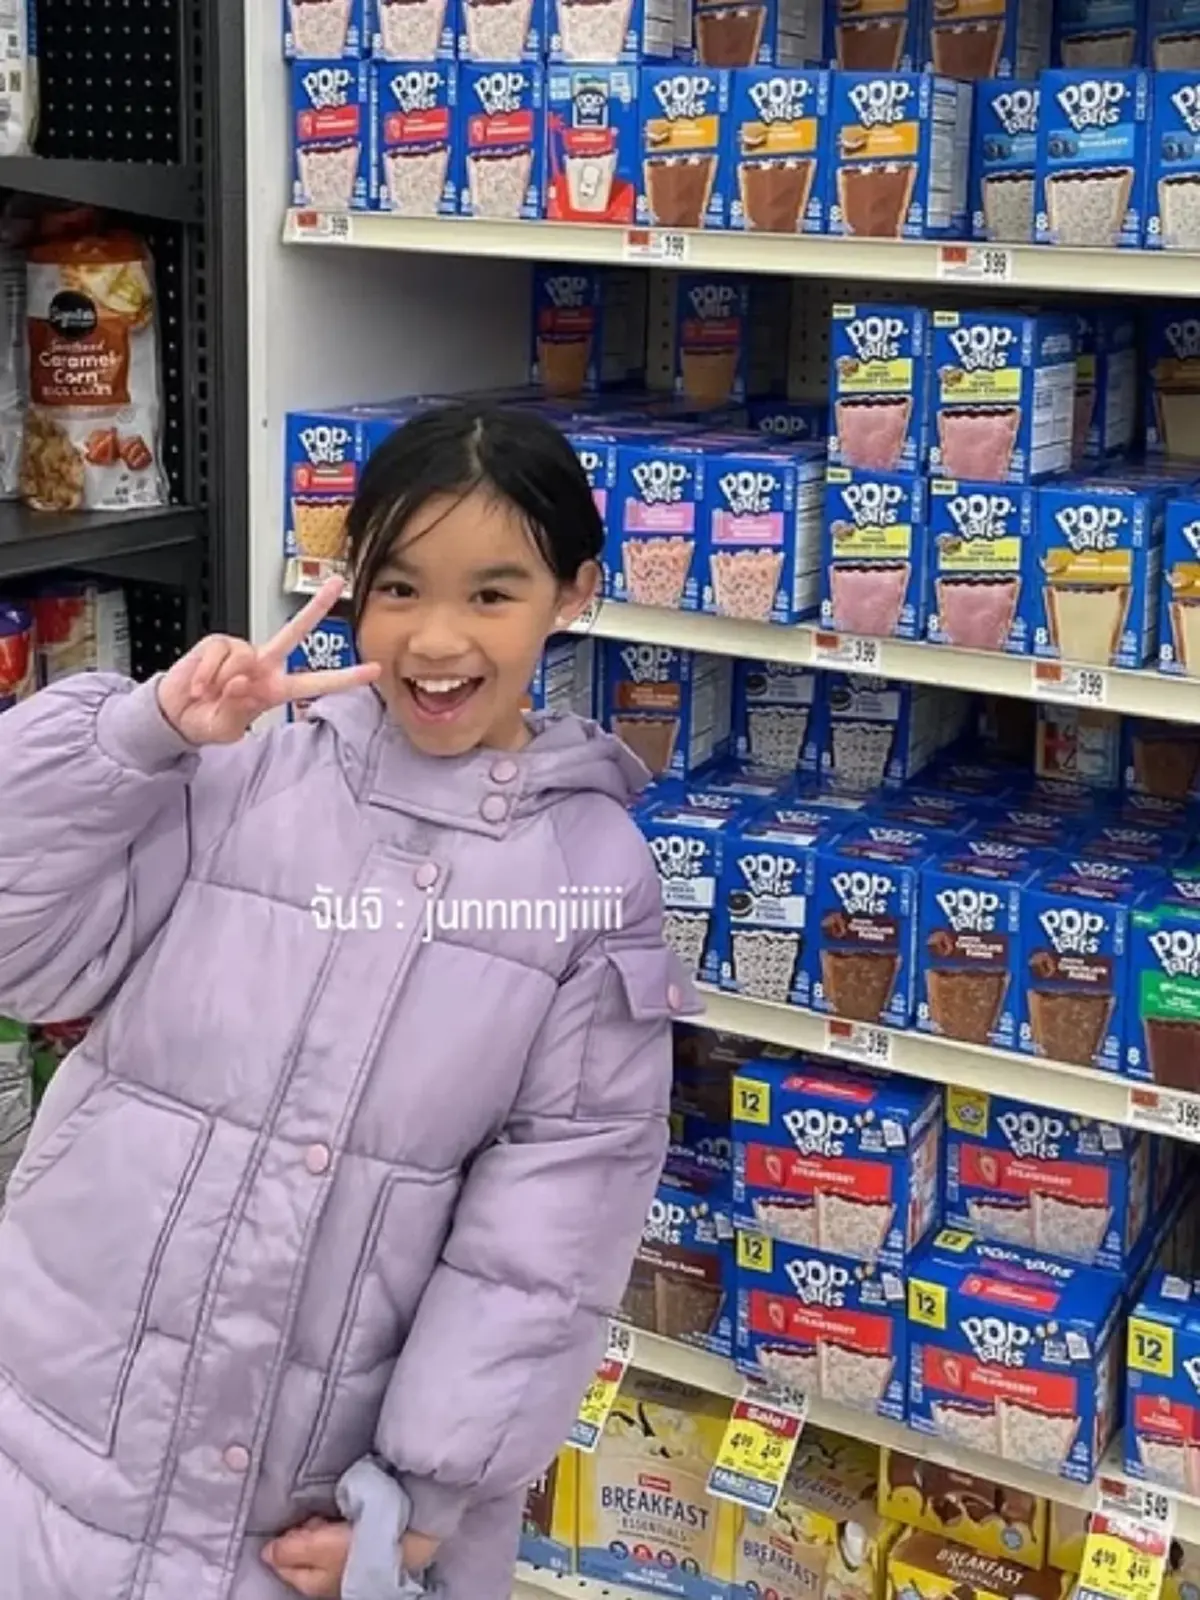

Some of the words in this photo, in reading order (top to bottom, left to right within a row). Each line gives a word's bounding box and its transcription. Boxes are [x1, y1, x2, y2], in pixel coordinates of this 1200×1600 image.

[740, 1090, 761, 1113] 12
[915, 1292, 937, 1316] 12
[1136, 1333, 1163, 1363] 12
[602, 1486, 709, 1531] BREAKFAST
[935, 1547, 1024, 1585] BREAKFAST
